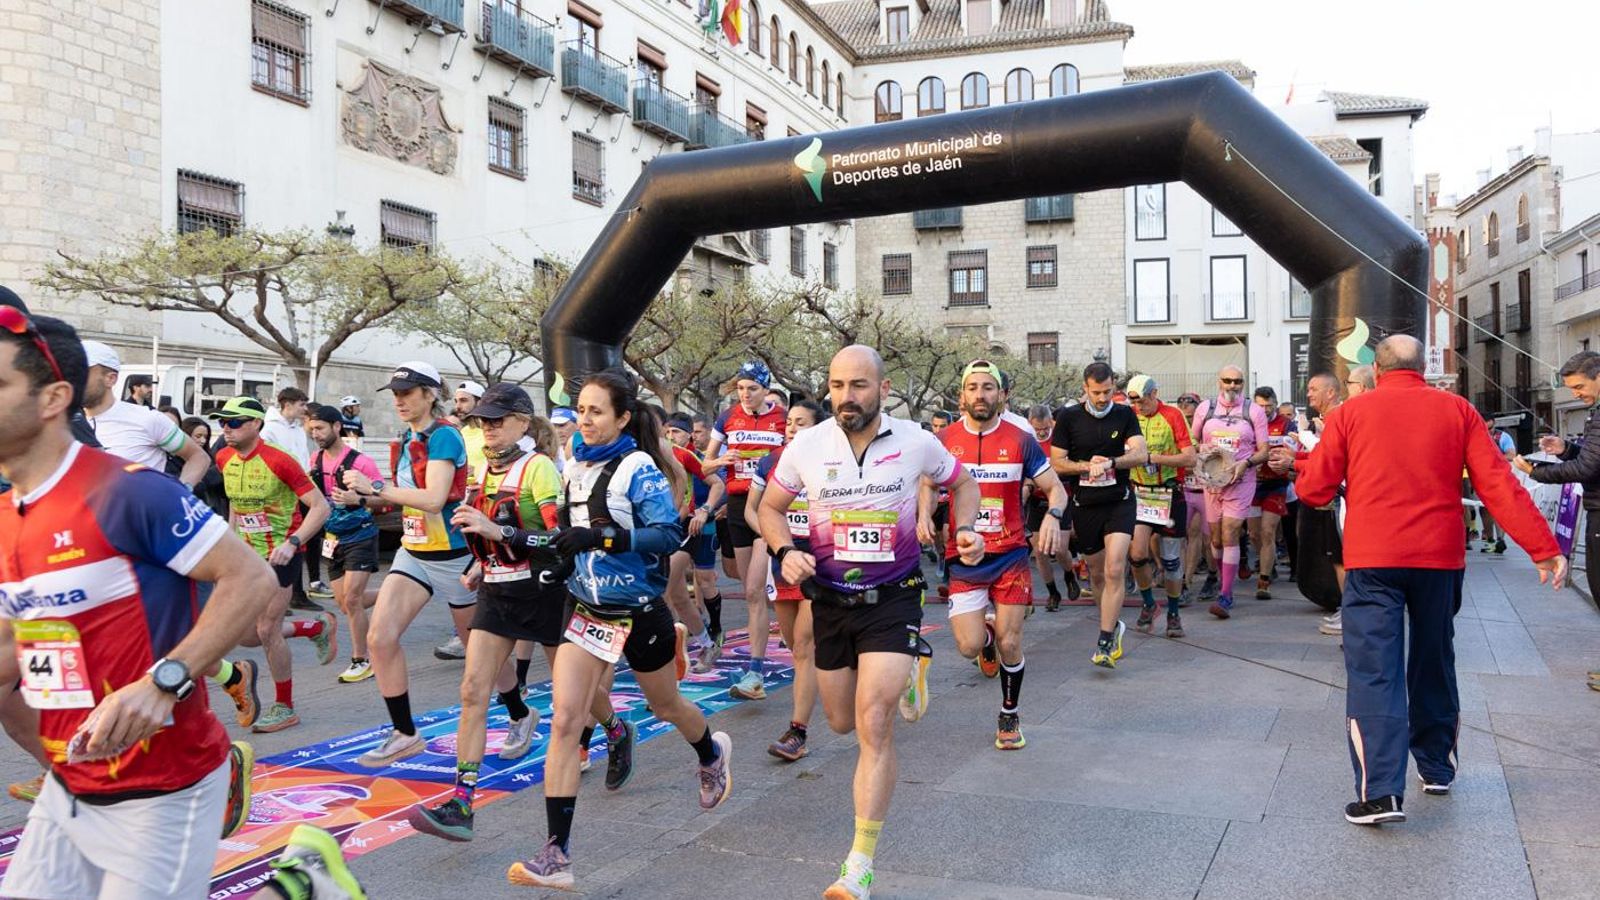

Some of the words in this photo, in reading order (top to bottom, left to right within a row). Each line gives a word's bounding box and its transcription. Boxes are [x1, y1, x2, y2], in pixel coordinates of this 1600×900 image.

[832, 149, 901, 168] Patronato
[905, 135, 978, 157] Municipal
[982, 131, 1002, 146] de
[833, 165, 899, 186] Deportes
[902, 160, 922, 175] de
[925, 156, 962, 175] Jaén
[745, 433, 776, 443] Avanza
[969, 468, 1008, 479] Avanza
[818, 486, 853, 500] SIERRA
[862, 483, 902, 497] SEGURA
[787, 514, 809, 524] 103
[849, 530, 880, 544] 133
[586, 625, 614, 644] 205
[28, 654, 53, 676] 44
